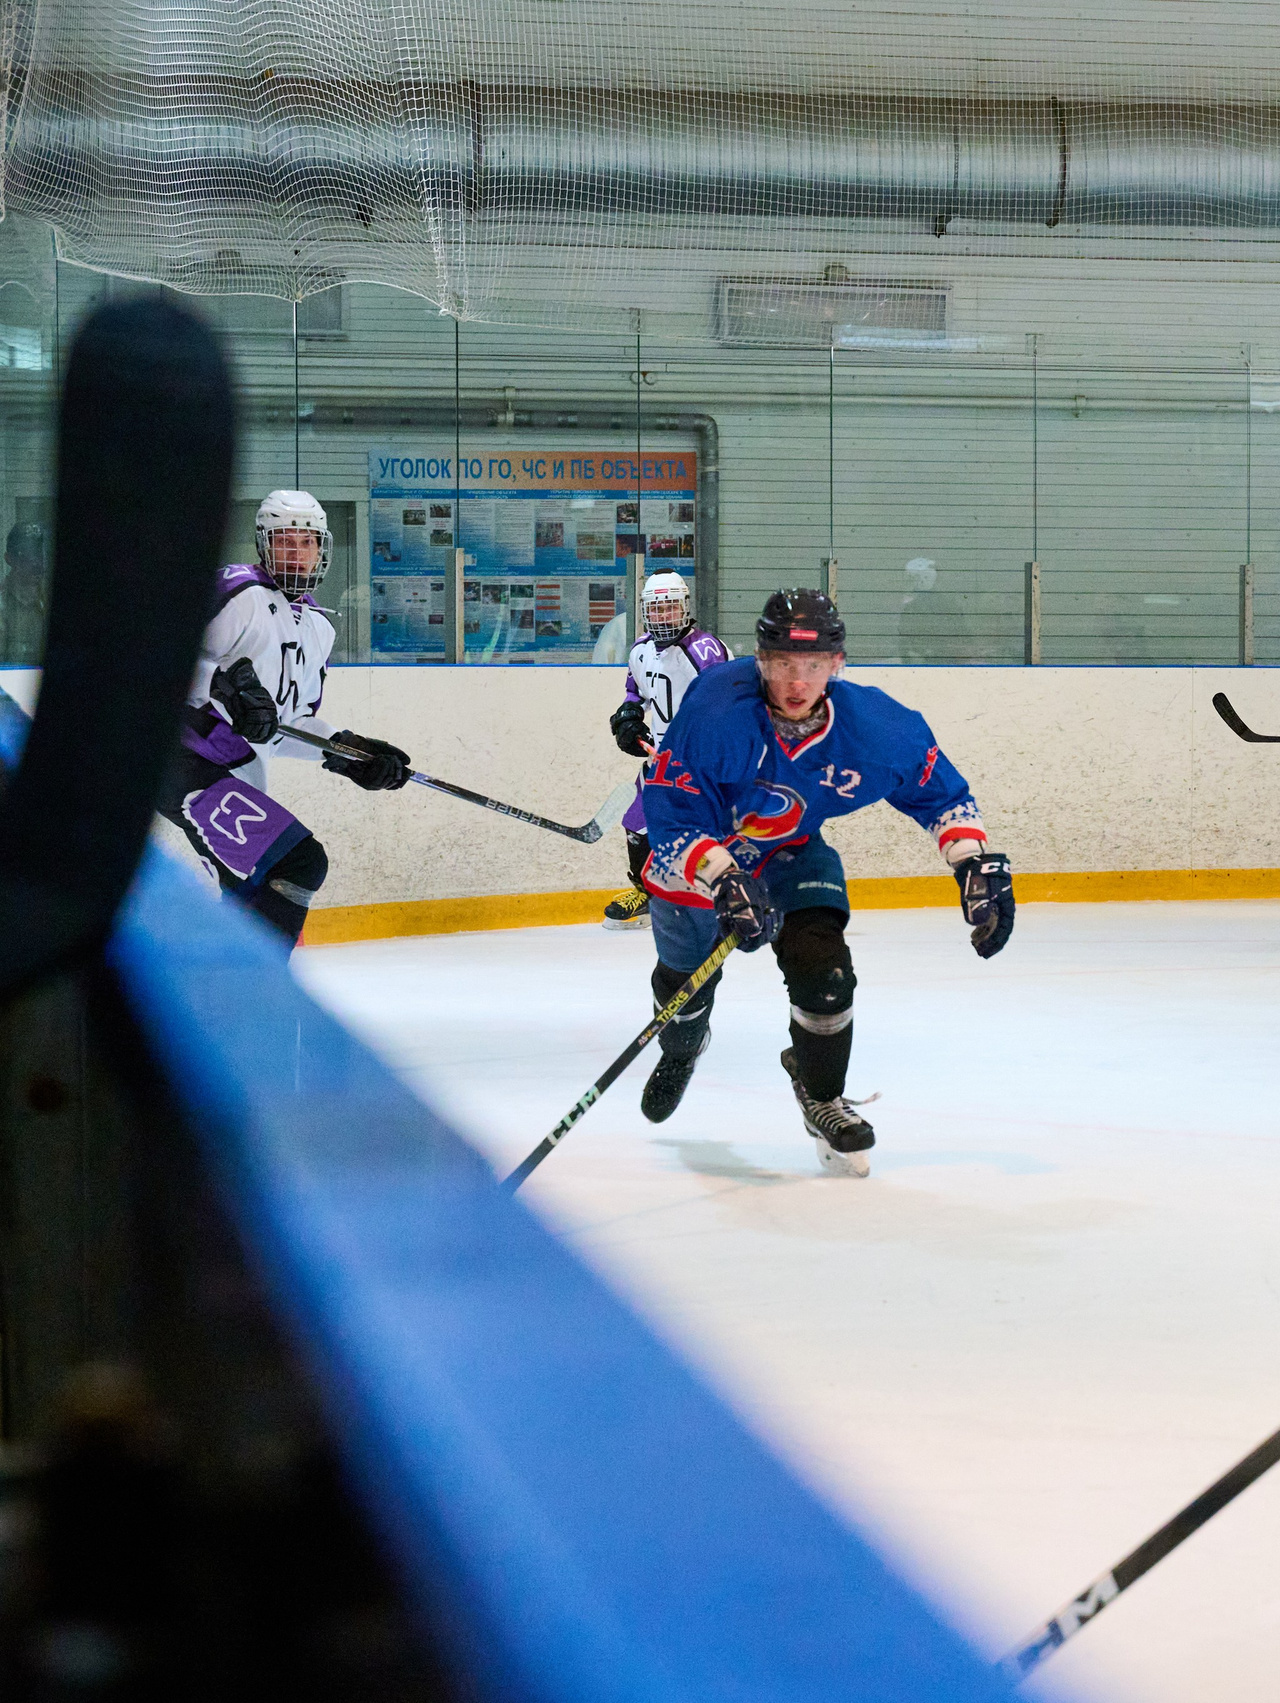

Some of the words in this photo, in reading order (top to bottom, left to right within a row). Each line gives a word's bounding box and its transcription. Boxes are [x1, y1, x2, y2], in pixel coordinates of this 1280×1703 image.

[379, 458, 451, 479] УГОЛОК
[457, 459, 483, 479] ПО
[489, 459, 516, 482] ГО,
[522, 459, 546, 479] ЧС
[553, 459, 564, 479] И
[571, 459, 595, 479] ПБ
[601, 459, 687, 479] ОБЪЕКТА
[819, 763, 861, 799] 12
[980, 861, 1011, 875] CC
[656, 990, 689, 1024] TACKS
[546, 1084, 602, 1147] CCM
